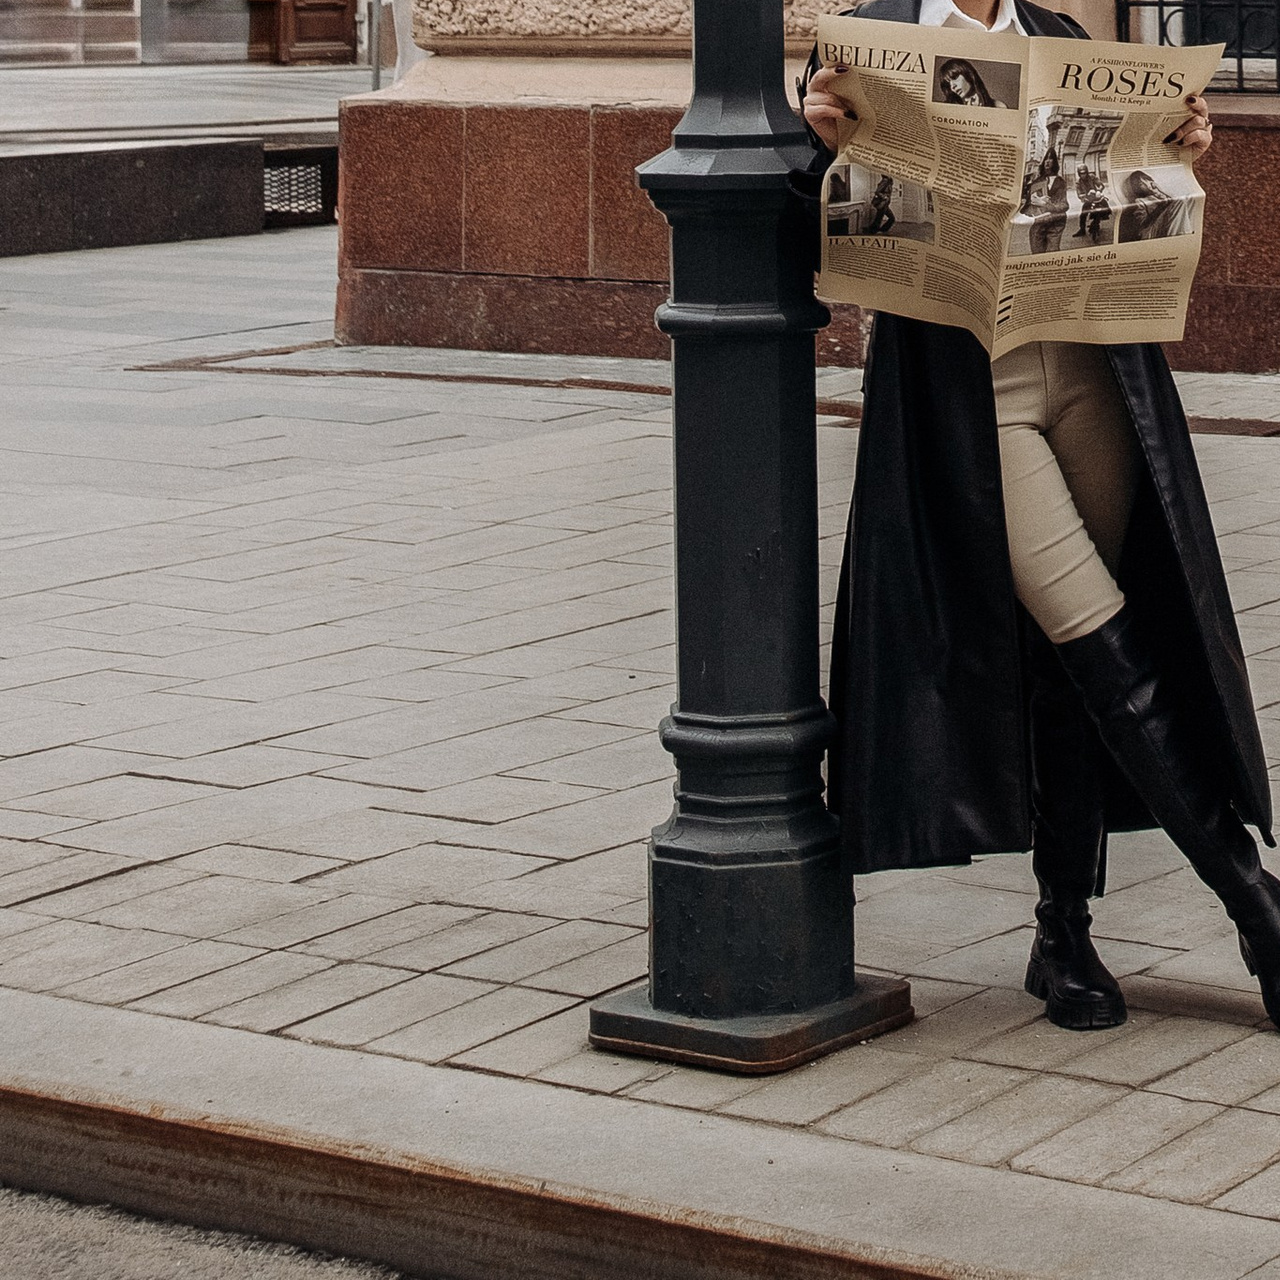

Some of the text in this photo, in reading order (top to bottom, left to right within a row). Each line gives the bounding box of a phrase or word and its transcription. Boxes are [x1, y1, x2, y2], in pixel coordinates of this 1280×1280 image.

[823, 43, 927, 74] BELLEZA
[1057, 63, 1186, 98] ROSES
[1127, 98, 1145, 106] Keep
[931, 115, 989, 128] CORONATION
[1005, 251, 1117, 271] najprosciej jak sie da
